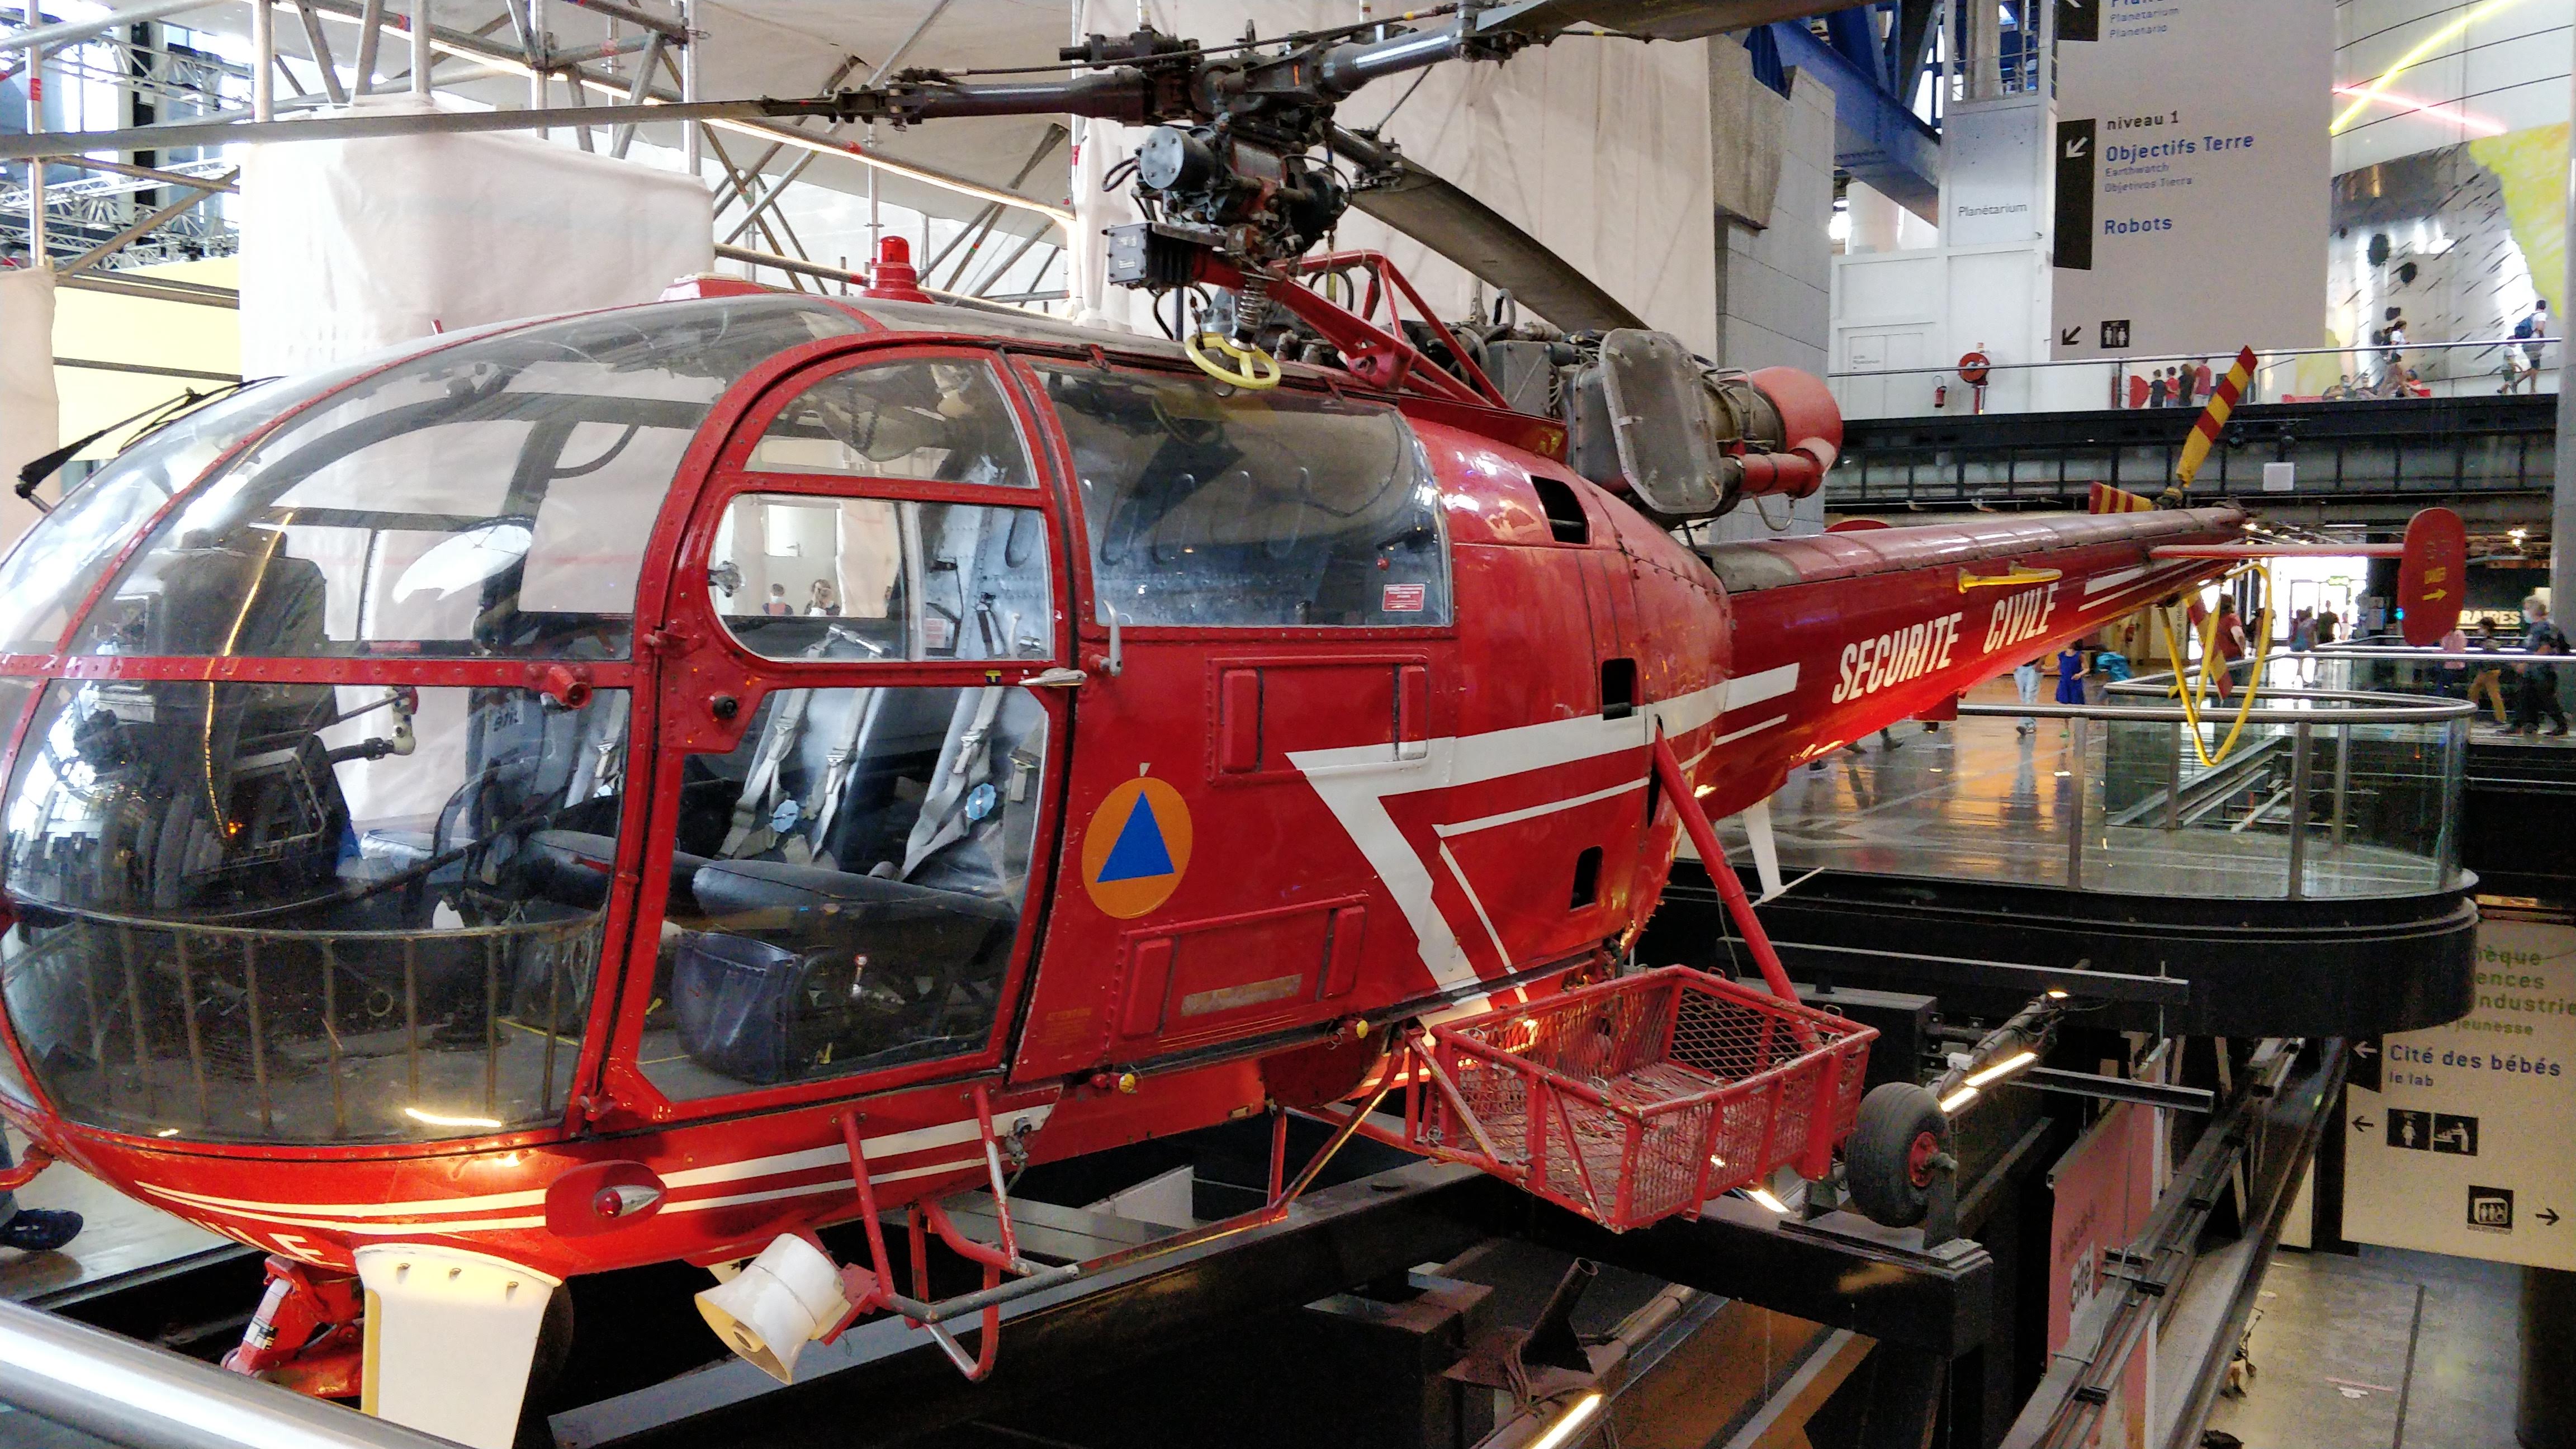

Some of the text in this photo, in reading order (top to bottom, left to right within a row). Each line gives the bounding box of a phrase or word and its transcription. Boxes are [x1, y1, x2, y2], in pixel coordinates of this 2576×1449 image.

[2107, 110, 2179, 130] niveau 1
[2106, 135, 2254, 164] Objectifs Terre
[2105, 162, 2170, 177] Earthwatch
[2160, 177, 2193, 187] Tierra
[2105, 216, 2173, 235] Robots
[2459, 610, 2521, 624] RAIRES
[1831, 582, 2059, 704] SECURITE CIVILE
[2476, 972, 2545, 989] ences
[2479, 993, 2576, 1016] ndustrie
[2390, 1044, 2561, 1077] Cité des bébés
[2389, 1071, 2434, 1087] le lab
